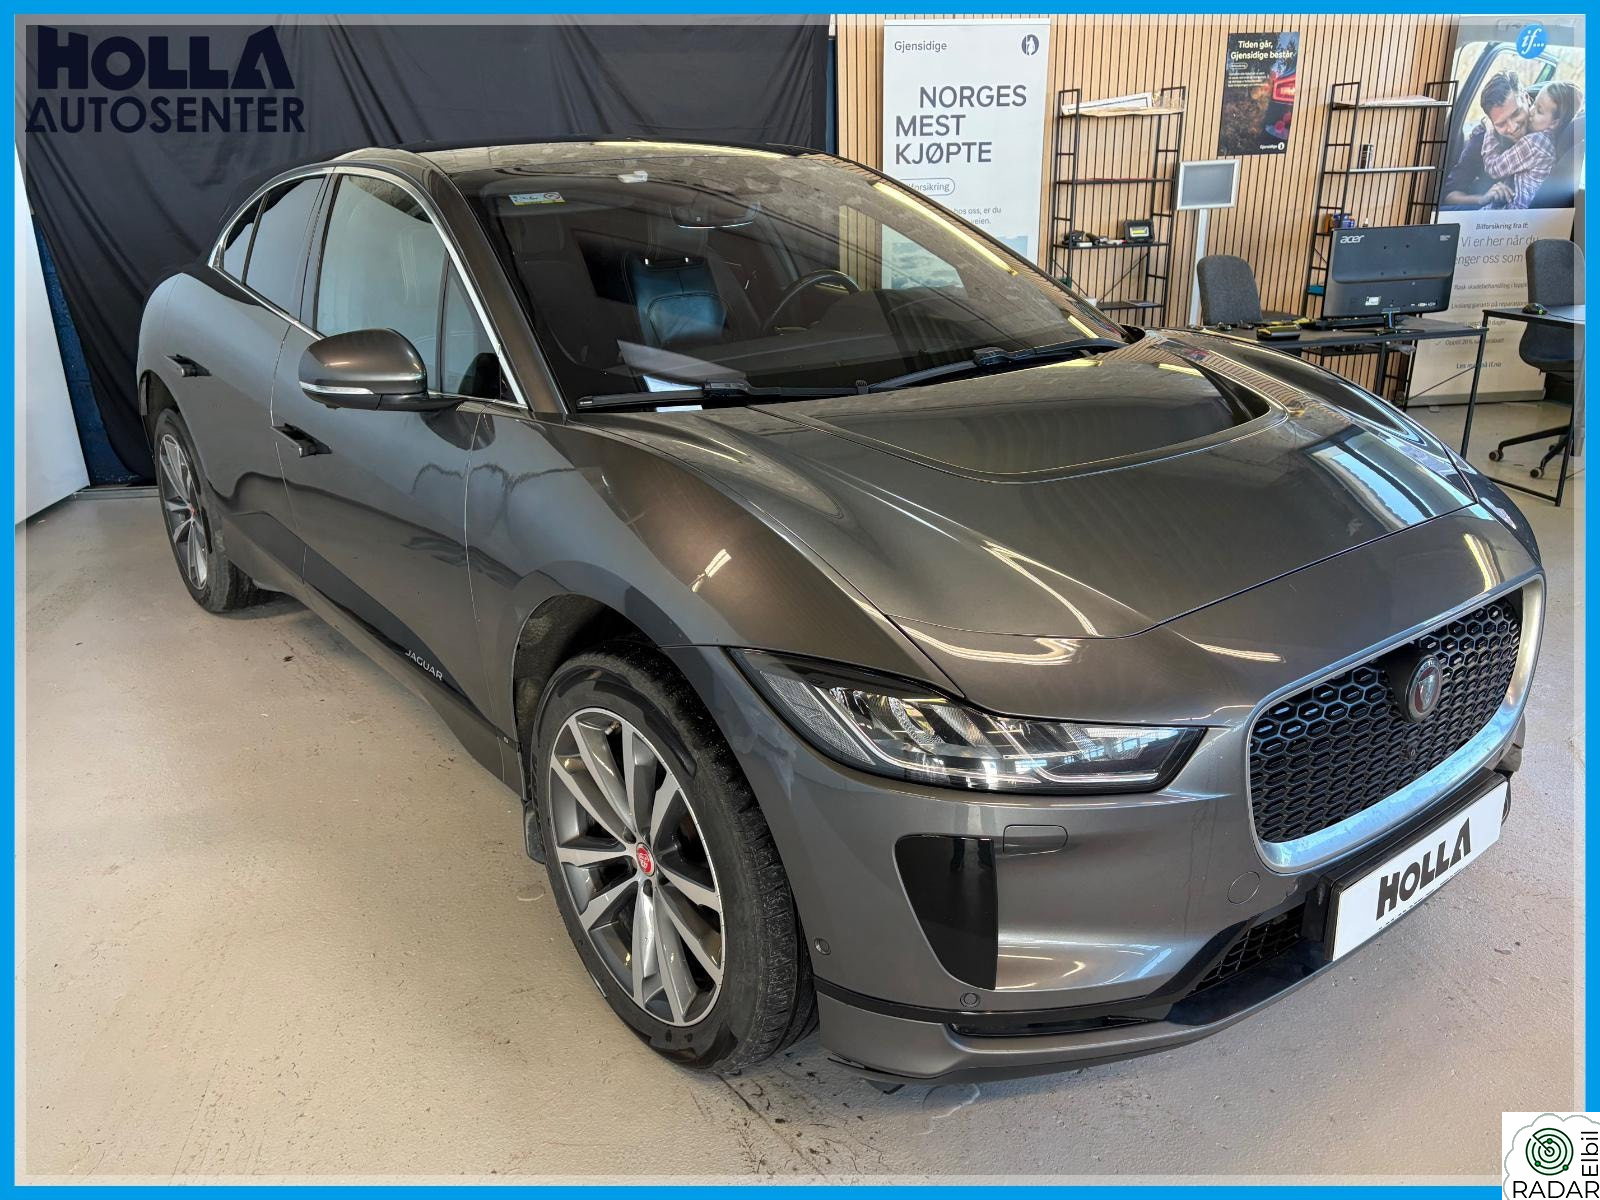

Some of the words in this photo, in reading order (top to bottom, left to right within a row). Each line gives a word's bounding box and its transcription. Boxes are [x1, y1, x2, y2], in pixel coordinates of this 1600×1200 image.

[894, 41, 948, 53] Gjensidige
[1238, 40, 1259, 49] Tiden
[1259, 40, 1274, 50] går,
[1230, 51, 1269, 61] Gjensidige
[1269, 50, 1294, 59] består
[919, 84, 1027, 109] NORGES
[895, 114, 966, 137] MEST
[895, 142, 993, 165] KJØPTE
[967, 207, 982, 216] oss,
[992, 205, 1002, 214] du
[1475, 223, 1513, 231] Bilforsikring
[1340, 235, 1365, 244] acer
[1461, 236, 1472, 248] Vi
[1473, 238, 1486, 247] er
[1486, 235, 1504, 247] her
[1506, 234, 1524, 246] når
[1482, 255, 1500, 264] oss
[1501, 253, 1524, 264] som
[405, 650, 443, 681] JAGUAR
[1375, 816, 1472, 921] HOLLA
